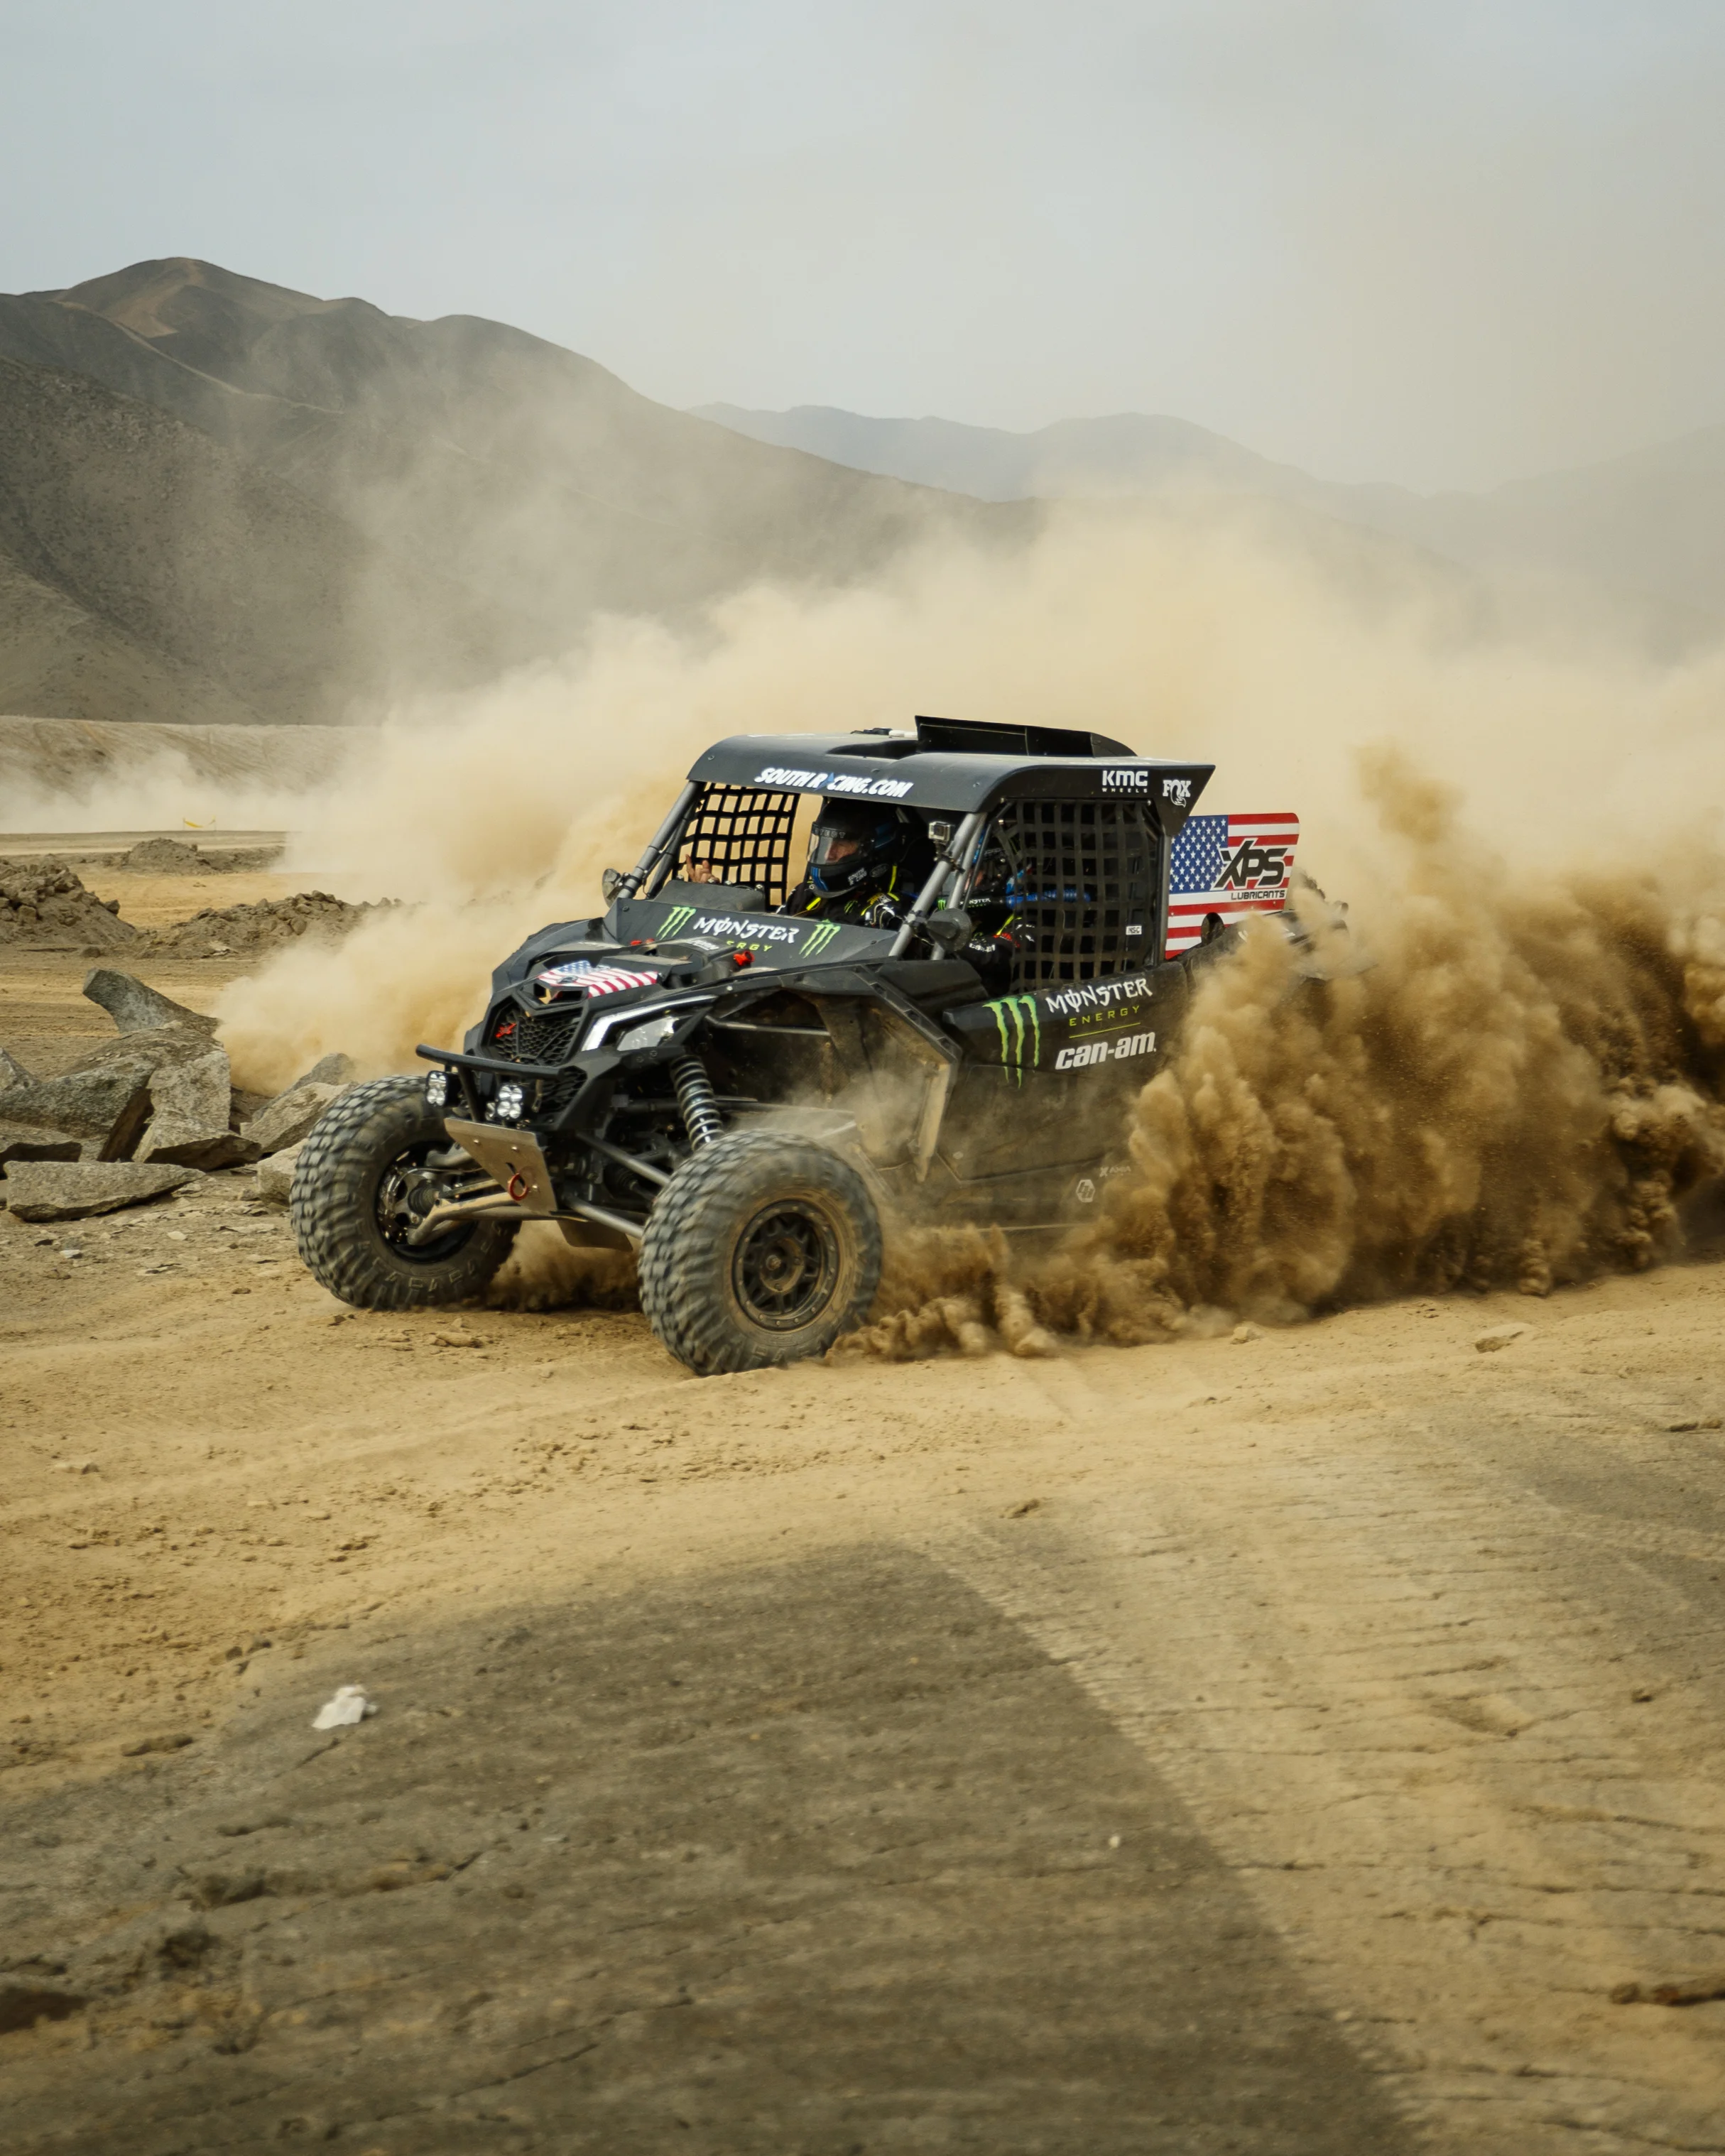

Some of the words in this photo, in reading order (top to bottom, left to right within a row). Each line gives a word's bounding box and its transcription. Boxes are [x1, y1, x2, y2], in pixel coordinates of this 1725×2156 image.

[1102, 771, 1148, 787] KMC
[1163, 779, 1192, 807] FOX
[1213, 840, 1289, 888] XPS
[1231, 890, 1285, 900] LUBRICANTS
[692, 917, 800, 944] MONSTER
[1045, 978, 1153, 1014] MONSTER
[1069, 1006, 1139, 1026] ENERGY
[1055, 1032, 1156, 1070] can-am
